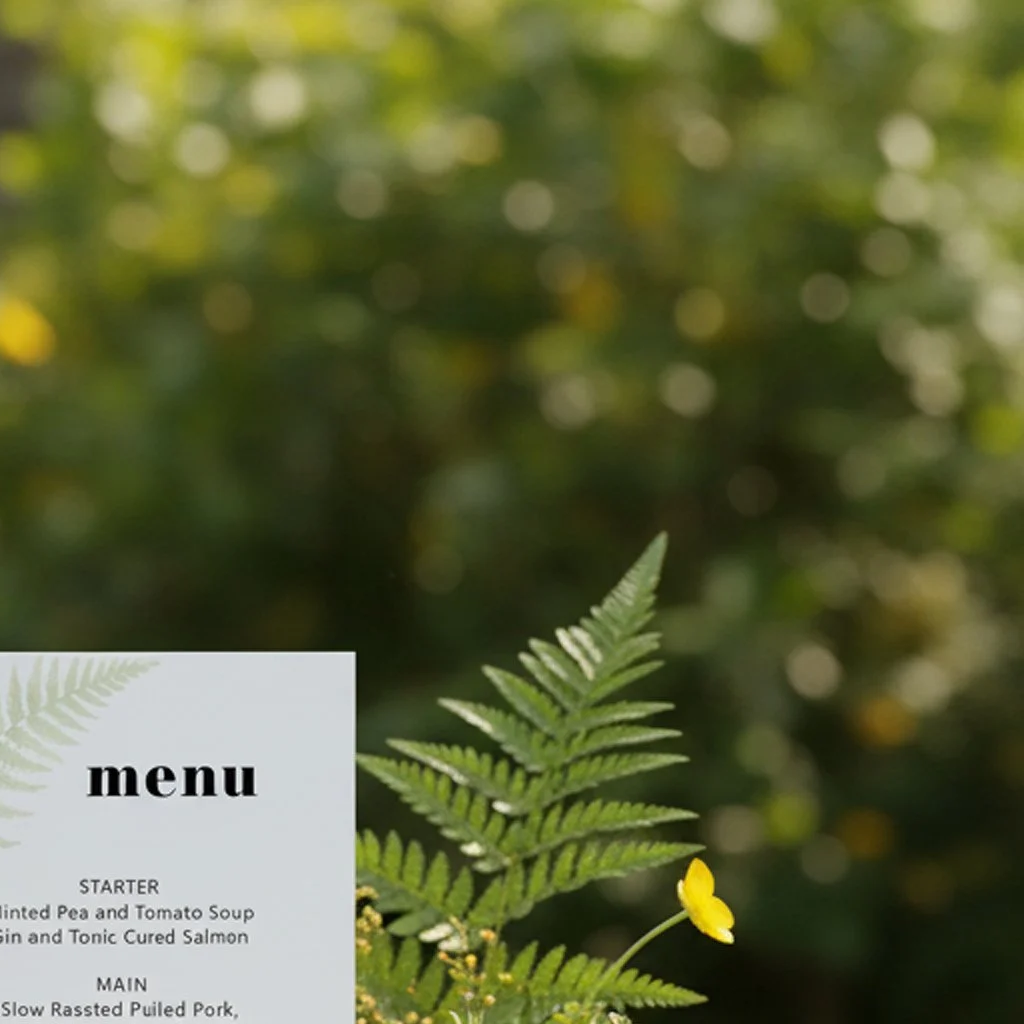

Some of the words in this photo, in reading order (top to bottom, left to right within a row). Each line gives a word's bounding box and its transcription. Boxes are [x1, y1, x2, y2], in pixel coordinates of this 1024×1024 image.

[87, 765, 257, 798] menu
[79, 879, 159, 894] STARTER
[57, 904, 89, 920] Pea
[95, 904, 129, 920] and
[135, 904, 203, 920] Tomato
[209, 904, 255, 924] Soup
[27, 929, 63, 945] and
[68, 929, 117, 945] Tonic
[123, 929, 175, 945] Cured
[182, 929, 249, 945] Salmon
[96, 977, 148, 992] MAIN
[1, 1001, 45, 1017] Slow
[193, 1001, 239, 1019] Pork,
